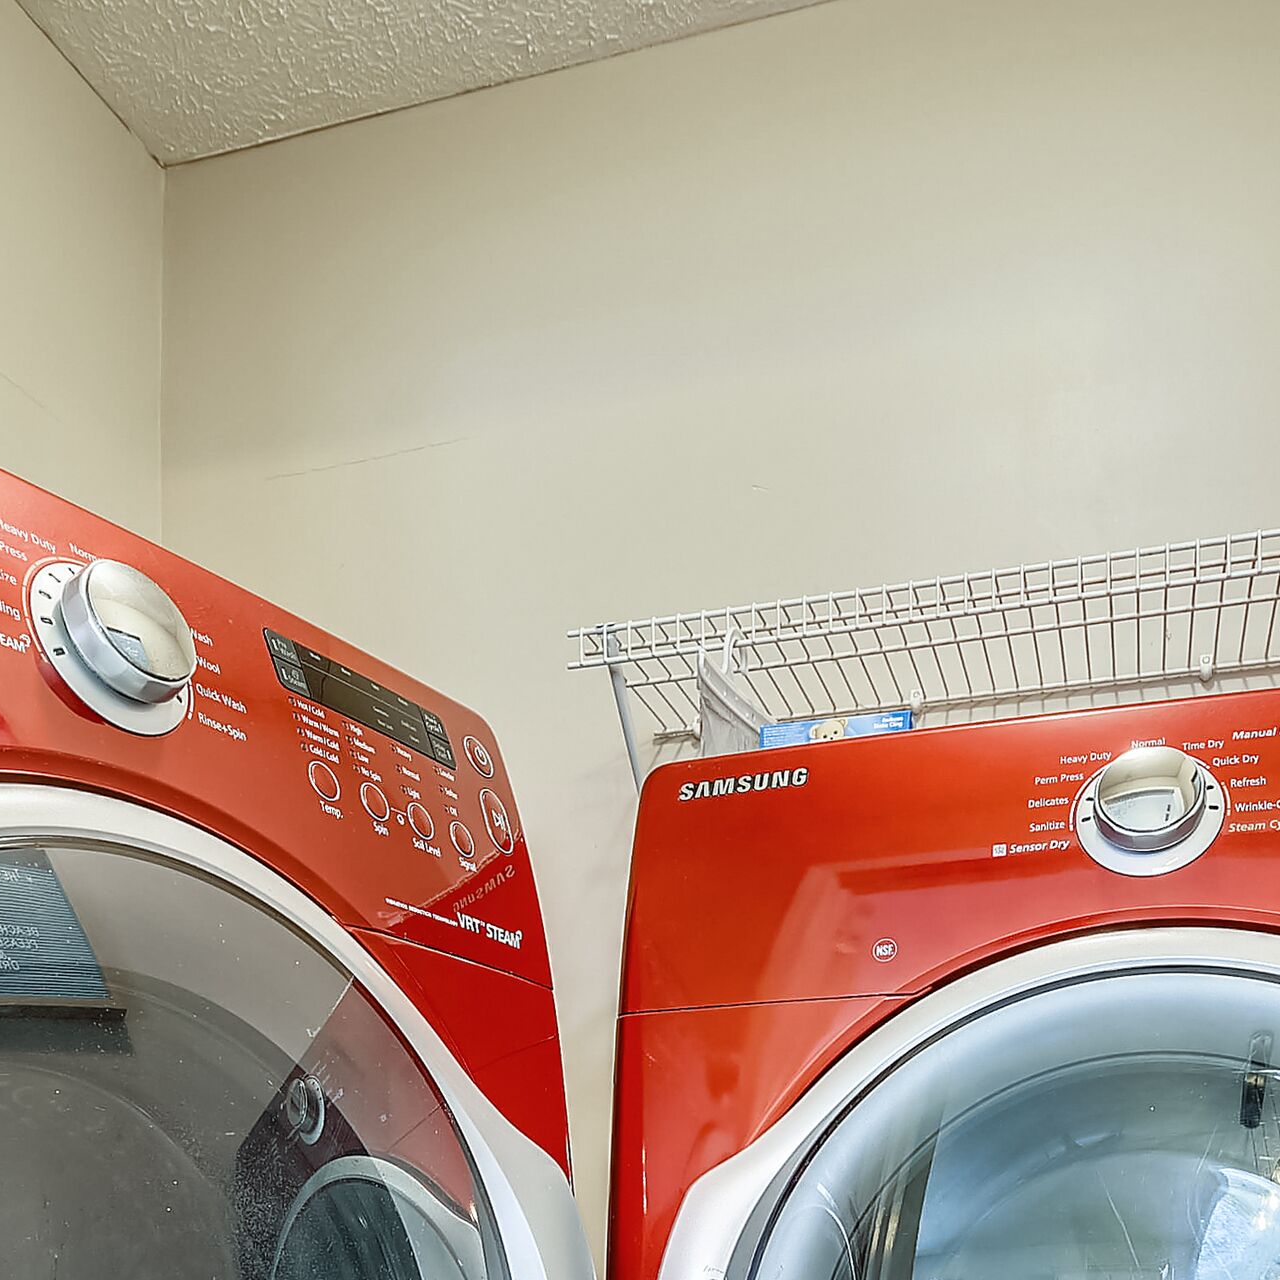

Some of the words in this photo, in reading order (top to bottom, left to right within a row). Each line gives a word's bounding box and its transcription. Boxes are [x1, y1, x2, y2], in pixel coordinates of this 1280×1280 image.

[30, 533, 57, 554] Duty
[69, 543, 101, 562] Norm
[196, 683, 221, 702] Quick
[221, 694, 247, 714] Wash
[198, 712, 247, 741] Rinse+Spin
[1232, 727, 1277, 740] Manual
[1131, 737, 1166, 748] Normal
[1182, 741, 1205, 751] Time
[1207, 739, 1224, 750] Dry
[1060, 755, 1088, 765] Heavy
[1090, 751, 1112, 762] Duty
[1212, 756, 1240, 767] Quick
[1242, 754, 1259, 765] Dry
[678, 768, 809, 801] SAMSUNG
[1034, 777, 1058, 785] Perm
[1060, 773, 1084, 783] Press
[1230, 776, 1267, 788] Refresh
[320, 801, 344, 819] Temp.
[1028, 797, 1069, 809] Delicates
[373, 821, 389, 836] Spin
[1029, 821, 1066, 832] Sanitize
[1228, 821, 1266, 833] Steam
[1009, 841, 1048, 854] Sensor
[1049, 839, 1070, 851] Dry
[486, 923, 521, 950] STEAM
